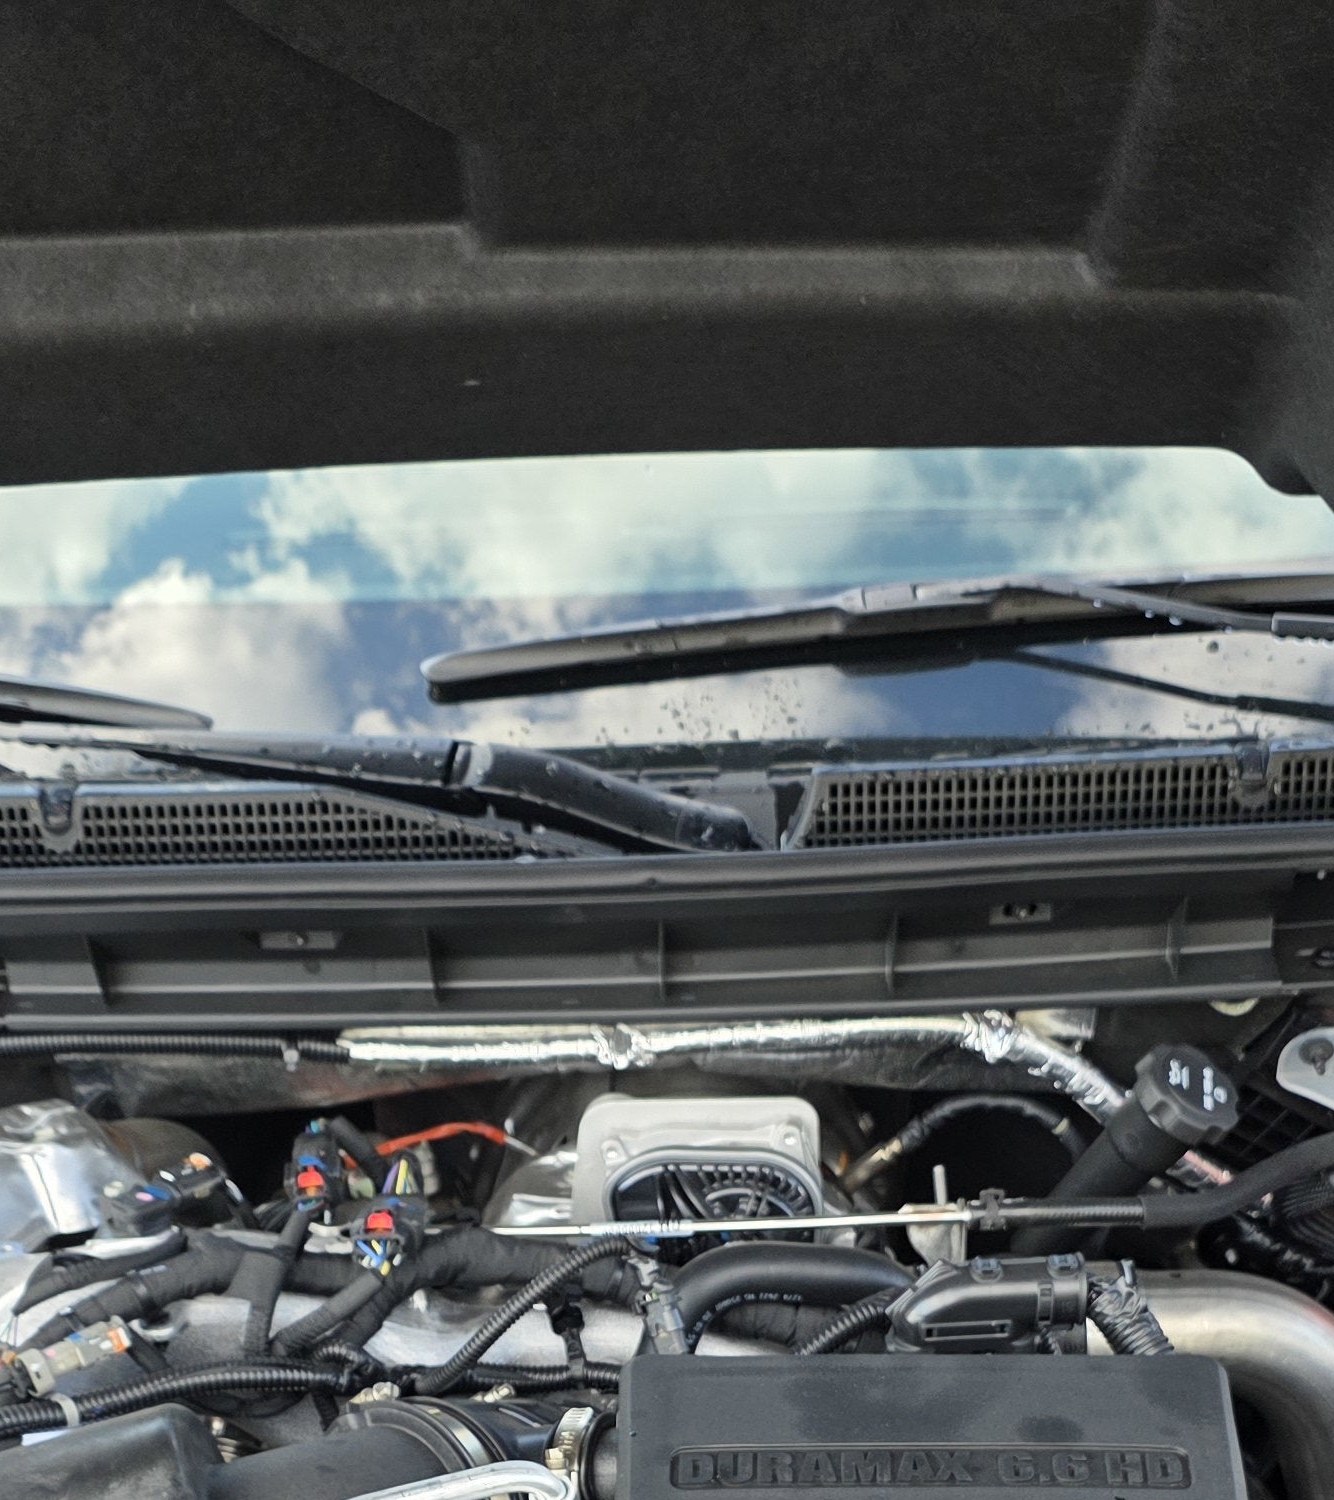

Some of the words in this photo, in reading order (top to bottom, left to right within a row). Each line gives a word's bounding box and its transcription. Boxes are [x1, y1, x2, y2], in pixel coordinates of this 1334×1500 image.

[678, 1451, 973, 1484] DURAMAX
[997, 1451, 1089, 1484] 6.6
[1105, 1452, 1186, 1486] HD
